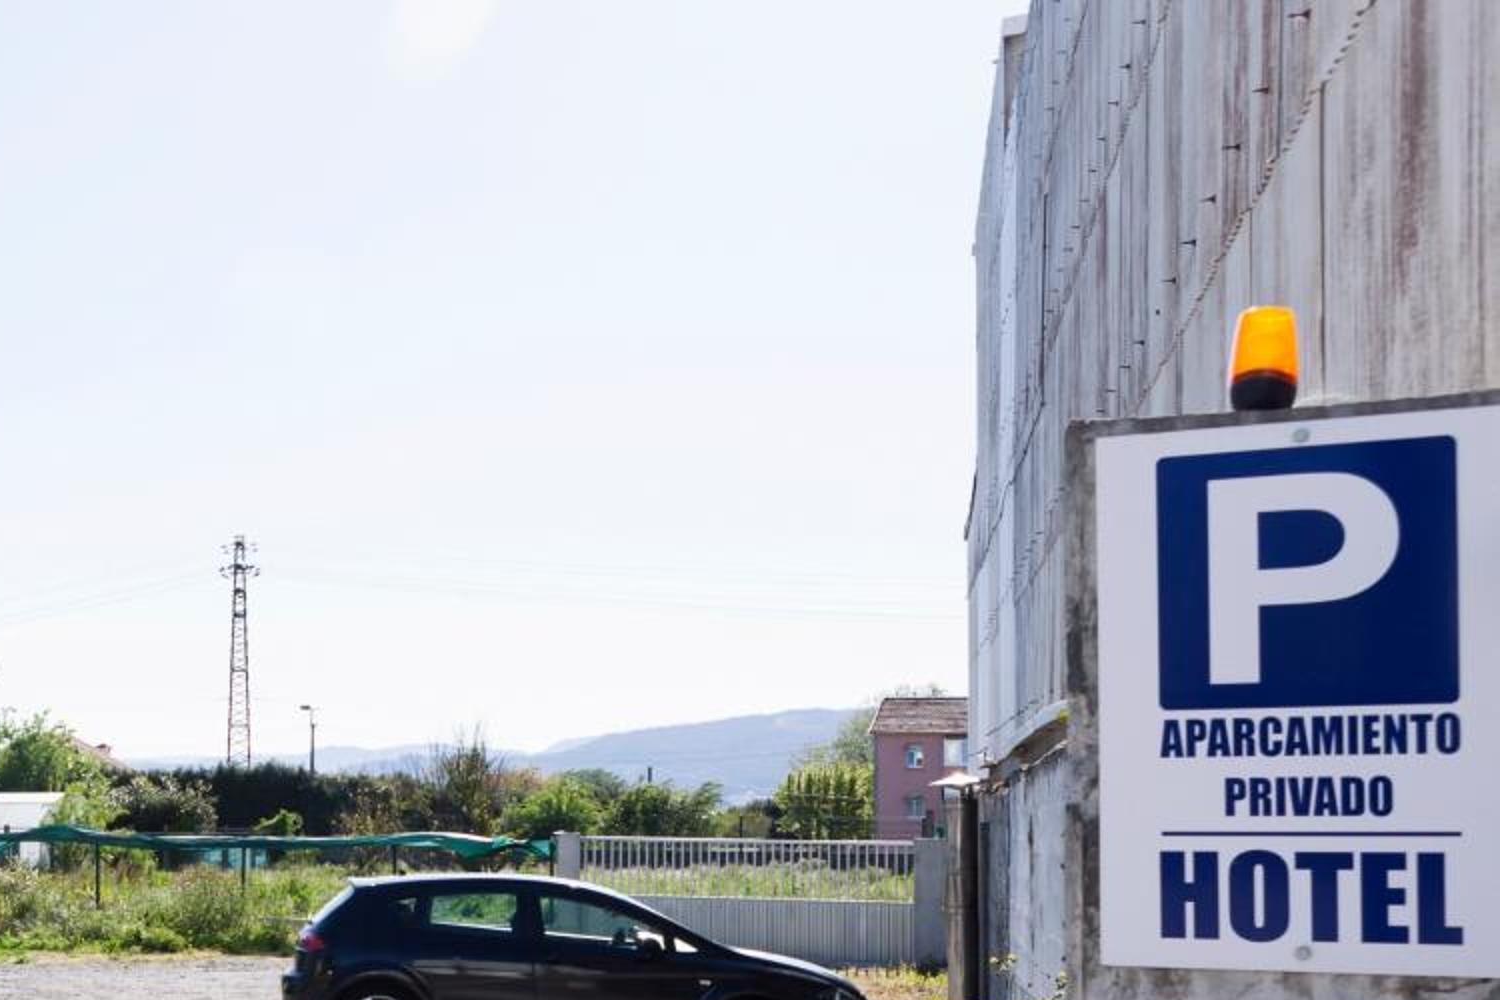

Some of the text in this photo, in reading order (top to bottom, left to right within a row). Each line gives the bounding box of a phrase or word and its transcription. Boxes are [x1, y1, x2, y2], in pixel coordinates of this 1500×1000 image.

[1208, 472, 1400, 685] P
[1160, 712, 1461, 758] APARCAMIENTO
[1224, 775, 1394, 817] PRIVADO
[1159, 849, 1464, 946] HOTEL
